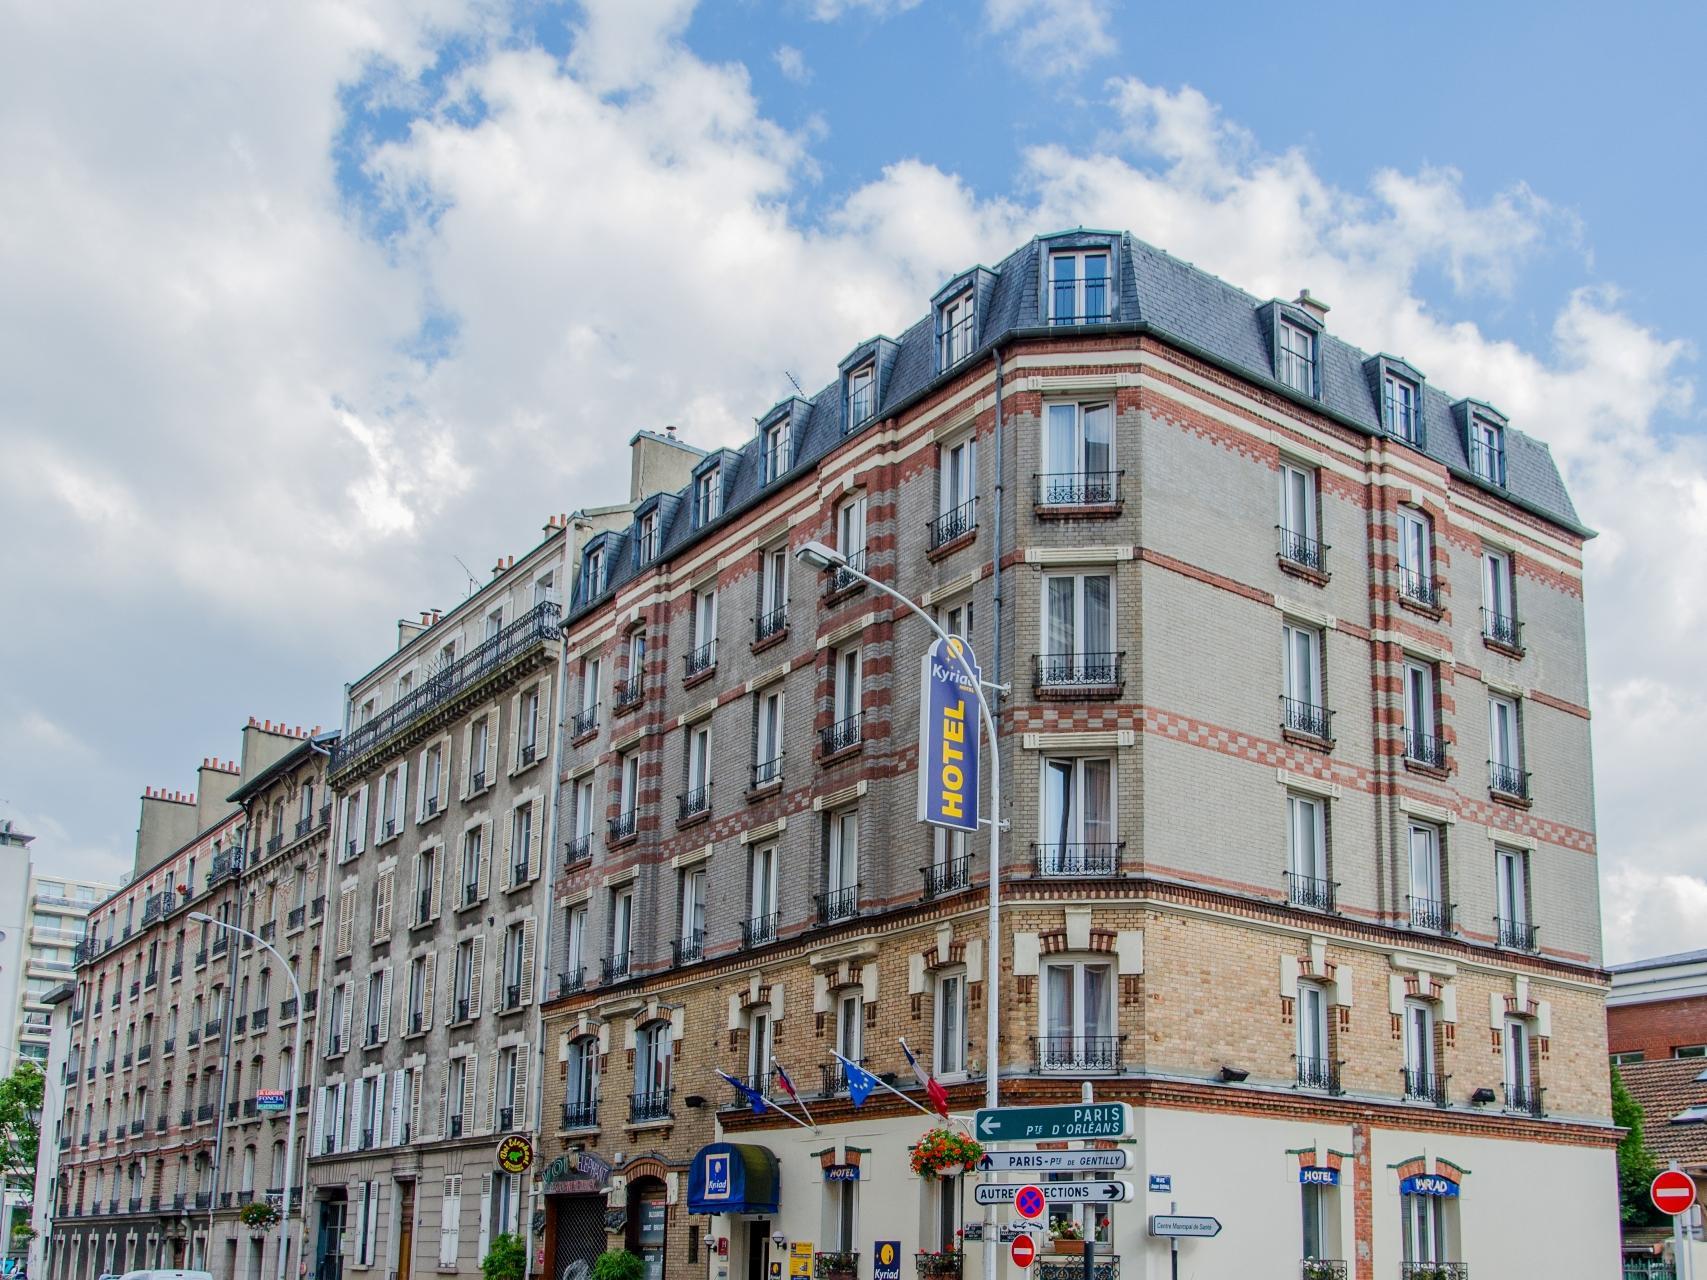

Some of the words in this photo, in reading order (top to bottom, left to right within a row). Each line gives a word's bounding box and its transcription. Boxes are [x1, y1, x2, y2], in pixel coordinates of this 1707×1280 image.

[942, 700, 965, 818] HOTEL
[1074, 1108, 1120, 1122] PARIS
[1052, 1122, 1120, 1135] D'ORLÉANS
[1080, 1156, 1121, 1166] GENTILLY
[1304, 1171, 1333, 1181] HOTEL
[1042, 1187, 1089, 1198] ECTIONS
[875, 1268, 899, 1280] Kyriad
